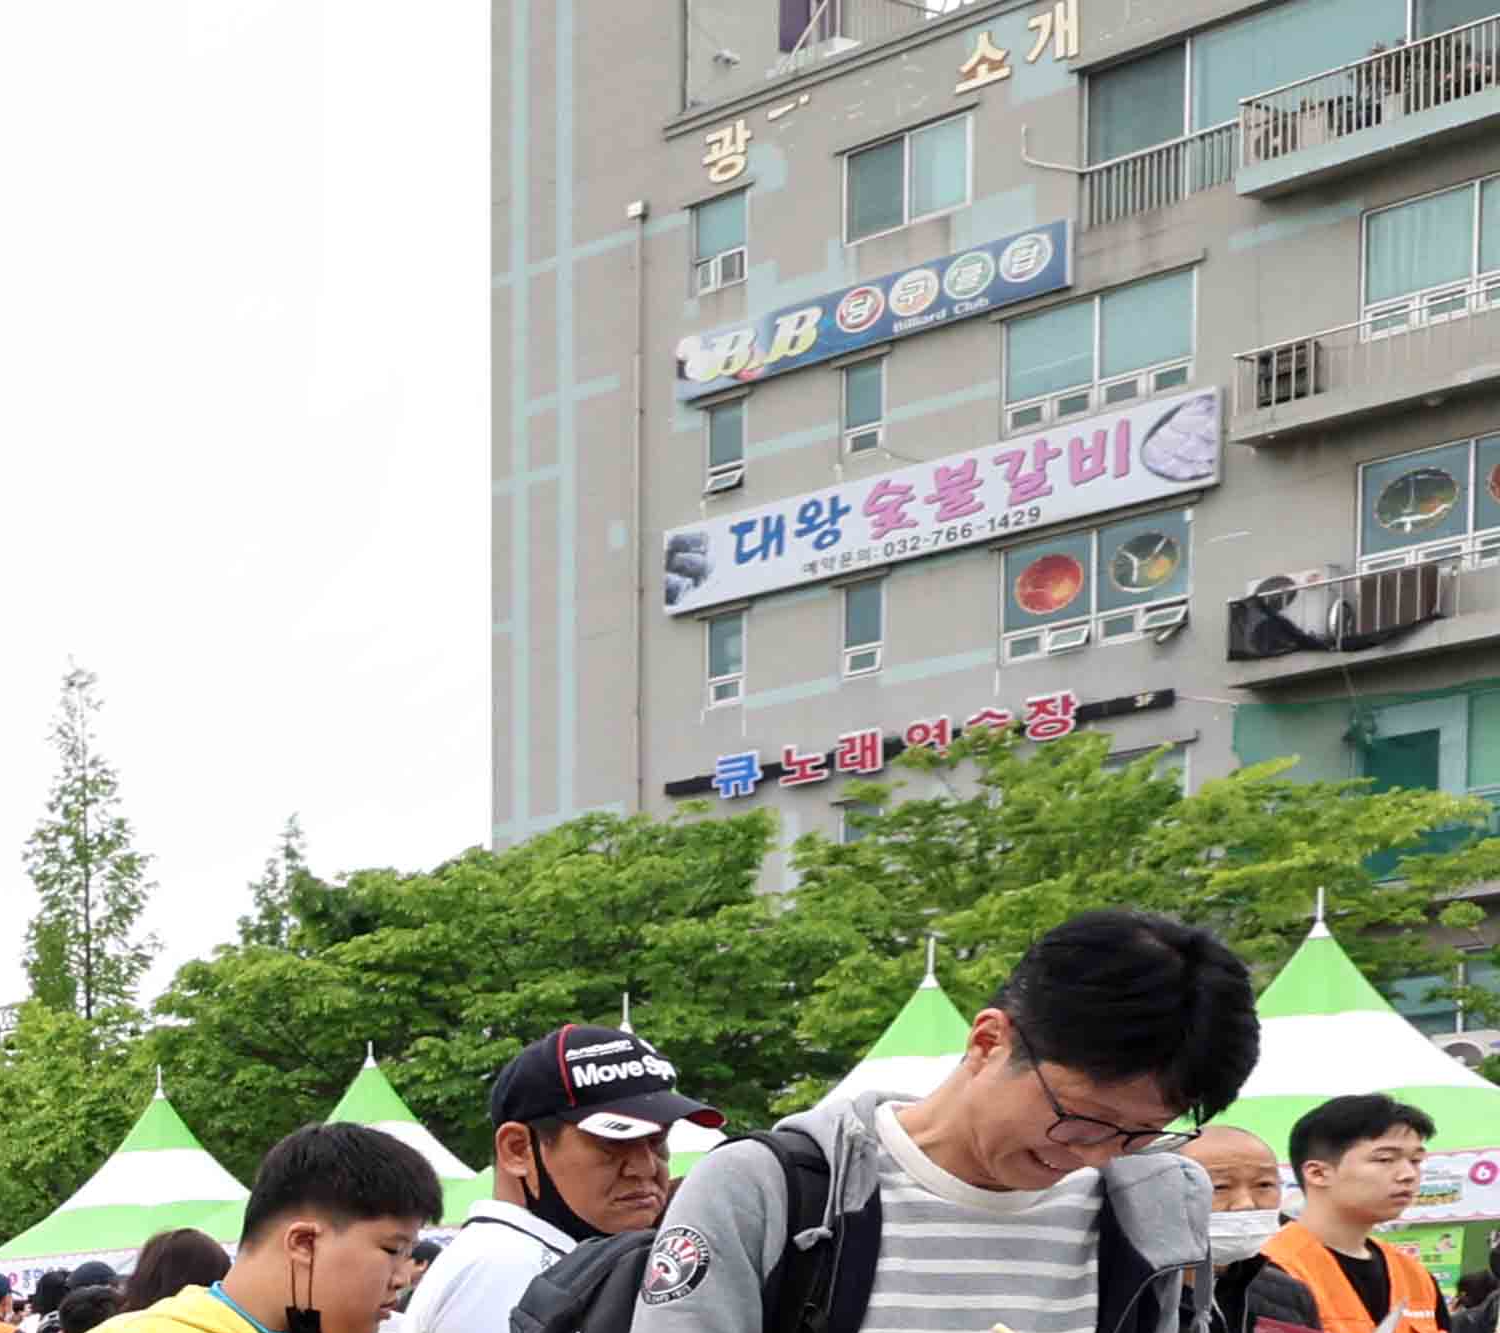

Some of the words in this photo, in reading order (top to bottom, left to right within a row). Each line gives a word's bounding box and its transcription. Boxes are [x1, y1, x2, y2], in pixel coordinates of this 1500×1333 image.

[953, 297, 989, 317] Club
[729, 495, 852, 565] 대왕
[861, 419, 1133, 540] 숯불갈비
[883, 507, 1042, 559] 032-766-1429
